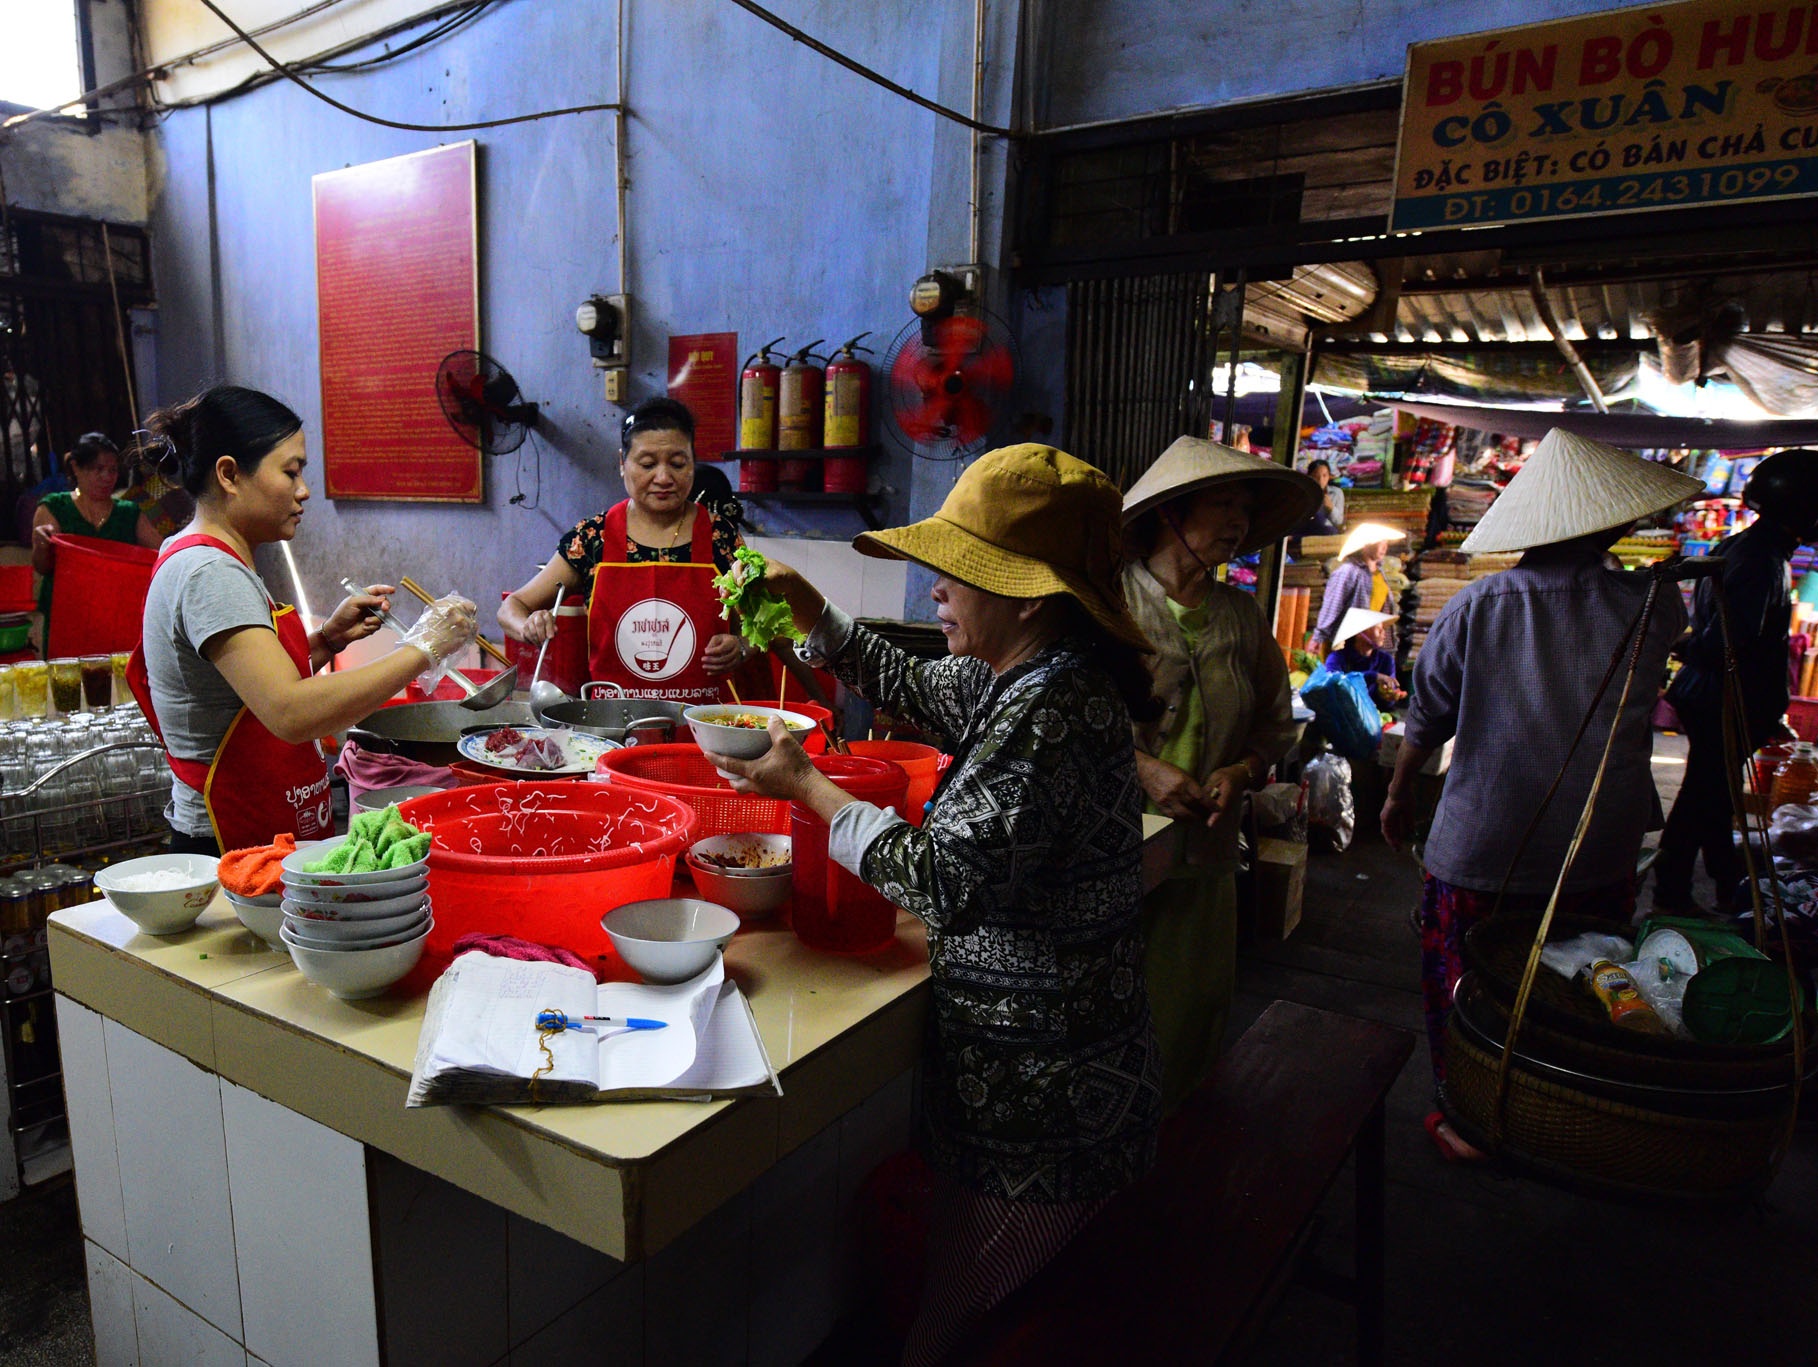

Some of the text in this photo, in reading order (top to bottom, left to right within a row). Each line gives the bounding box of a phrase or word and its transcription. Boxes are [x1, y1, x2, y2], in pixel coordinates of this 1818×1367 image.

[1426, 40, 1558, 106] BÚN
[1579, 15, 1674, 86] BÒ
[1432, 79, 1735, 148] CÔ XUÂN
[1414, 158, 1471, 191] ĐẶC
[1483, 151, 1559, 186] BIỆT:
[1569, 142, 1611, 172] CÓ
[1623, 134, 1688, 167] BÁN
[1697, 123, 1765, 159] CHẢ
[1443, 194, 1497, 221] ĐT:
